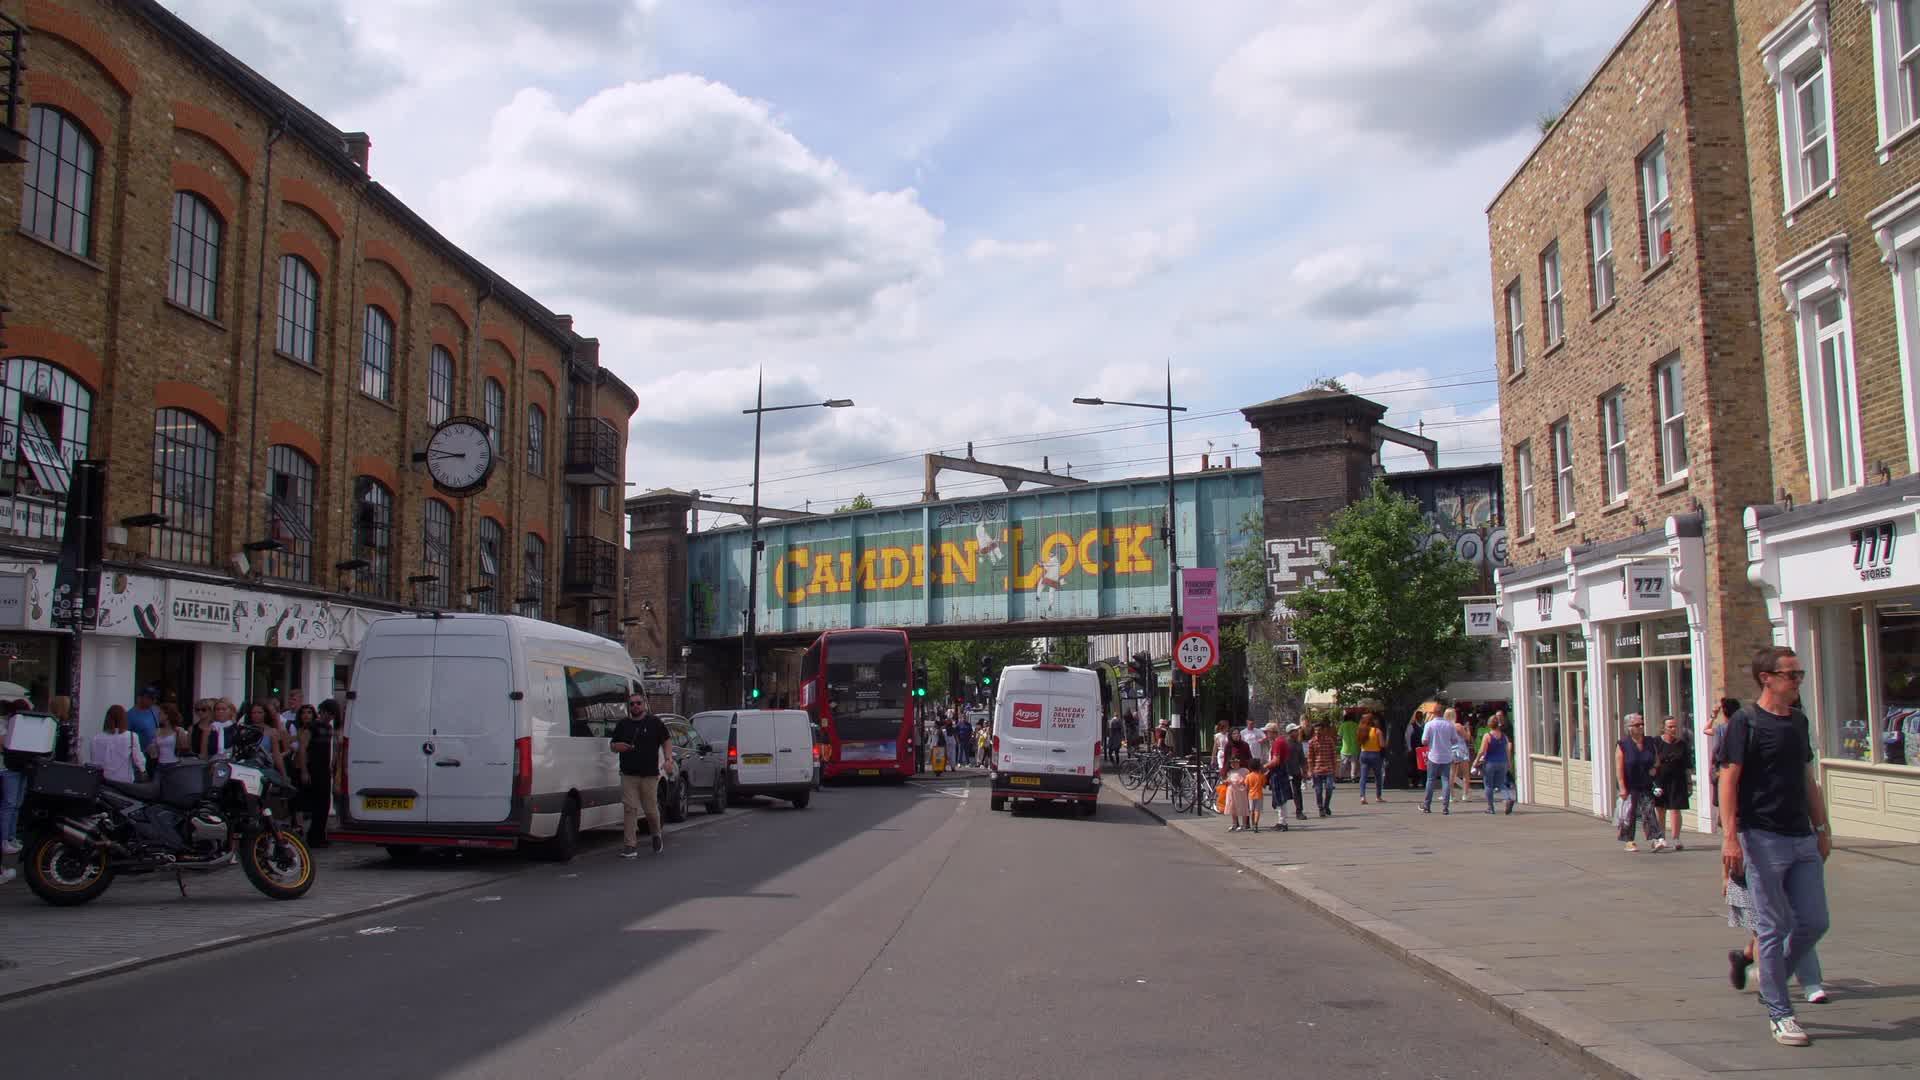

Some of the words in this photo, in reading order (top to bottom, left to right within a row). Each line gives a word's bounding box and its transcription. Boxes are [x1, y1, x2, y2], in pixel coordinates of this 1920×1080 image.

[1849, 520, 1897, 570] 777
[775, 539, 979, 604] CAMDEN
[1003, 524, 1154, 592] LOCK
[1860, 567, 1892, 581] STORES
[1633, 577, 1664, 592] 777
[173, 601, 200, 618] CAFE
[207, 605, 231, 621] NATA
[1470, 612, 1492, 623] 777
[1182, 643, 1199, 652] 4.8
[1615, 635, 1641, 647] CLOTHES
[1016, 708, 1040, 719] Argos
